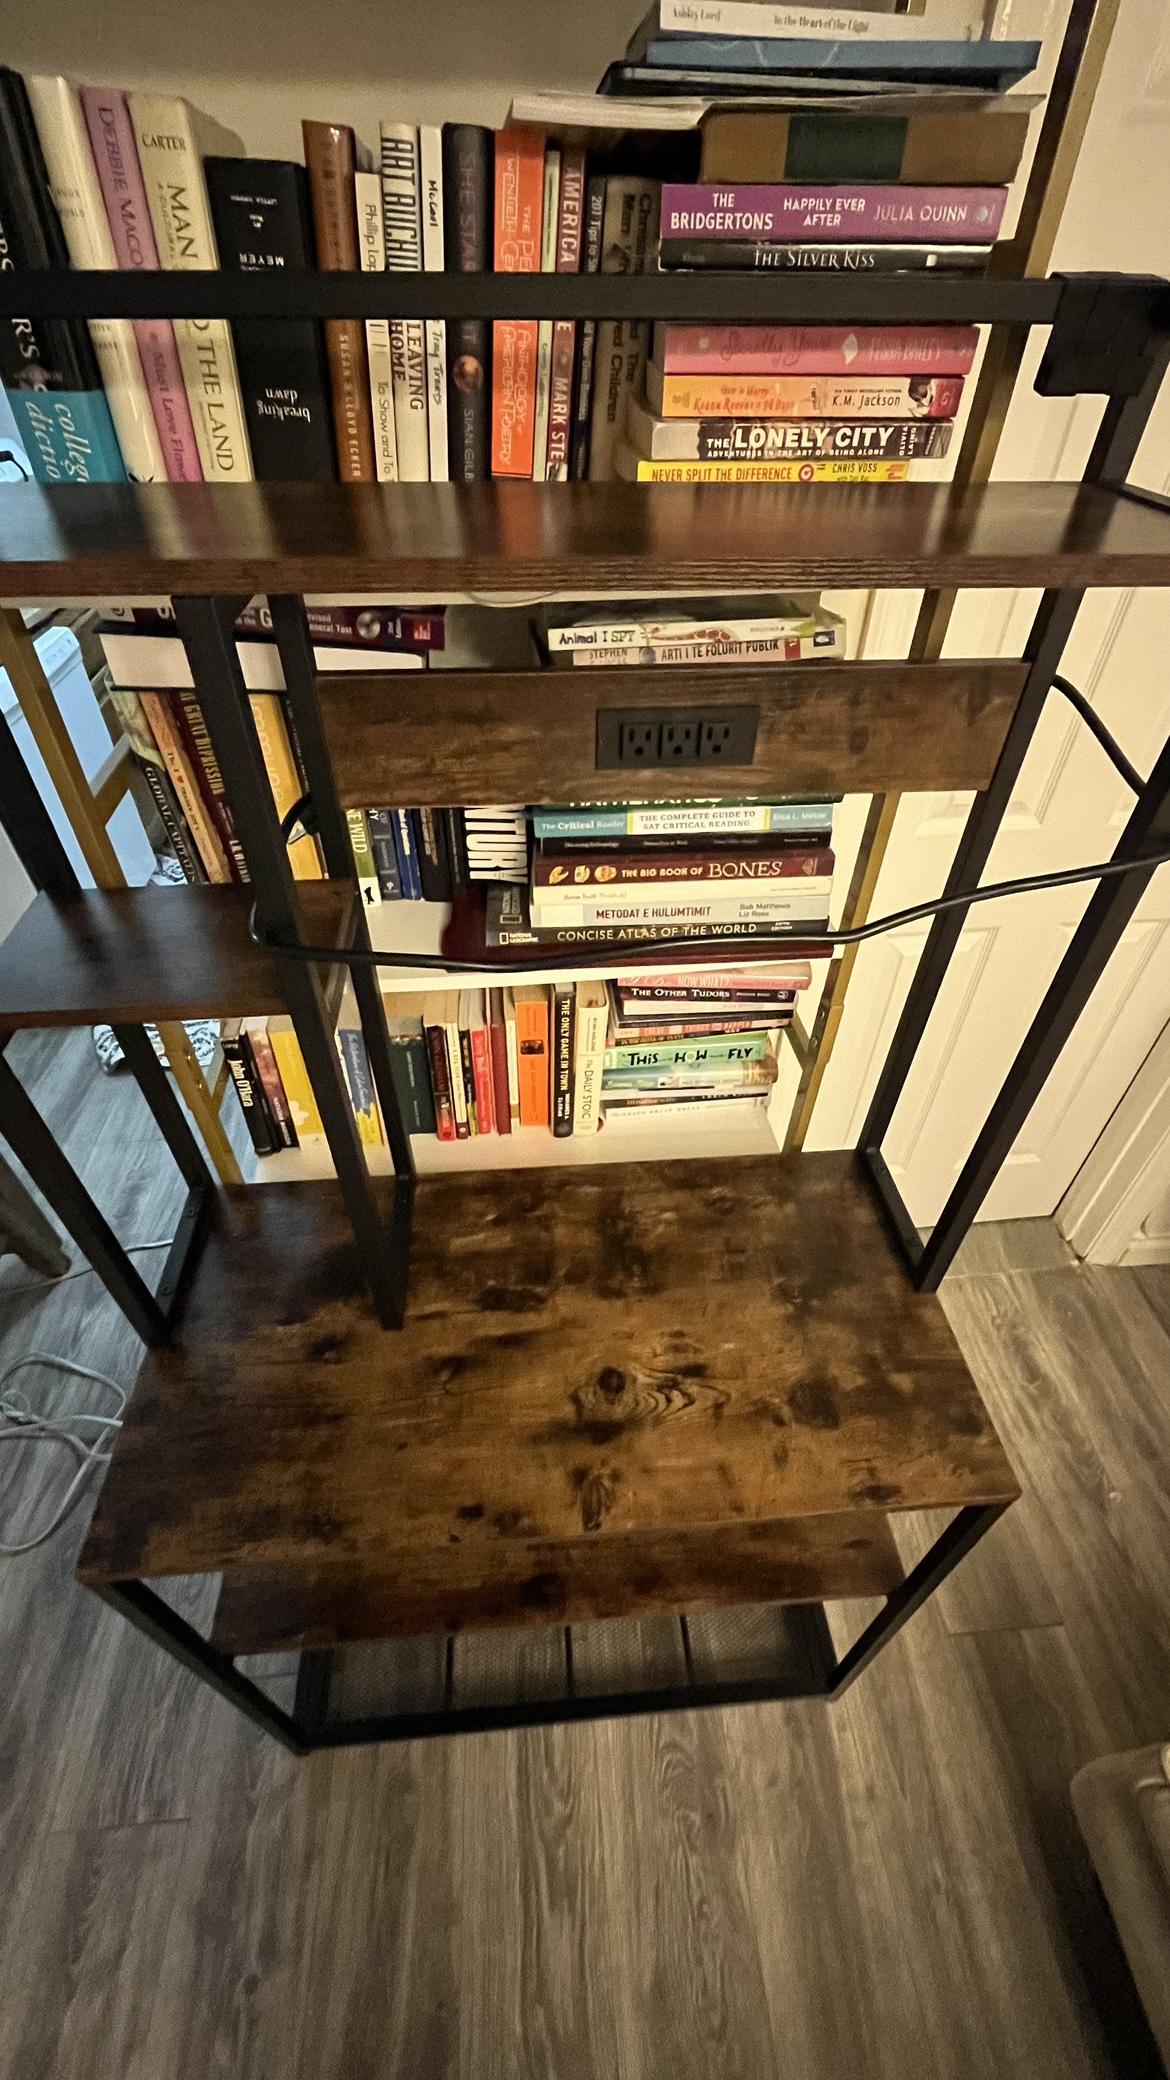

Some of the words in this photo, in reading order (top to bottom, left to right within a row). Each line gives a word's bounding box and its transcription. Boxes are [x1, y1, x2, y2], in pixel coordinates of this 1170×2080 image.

[99, 107, 128, 191] DEBBIE
[142, 134, 186, 150] CARTER
[381, 137, 415, 186] ART
[591, 196, 602, 217] 201
[712, 193, 735, 208] THE
[783, 198, 834, 212] HAPPILY
[835, 198, 866, 212] EVER
[167, 184, 198, 259] MAN
[522, 205, 531, 233] THE
[560, 167, 581, 262] AMERICA
[671, 212, 773, 230] BRIDGERTONS
[803, 213, 841, 227] AFTER
[873, 204, 914, 222] JULIA
[919, 205, 968, 222] QUINN
[364, 203, 378, 246] Phillip
[587, 219, 601, 244] Tips
[239, 253, 284, 267] MEYER
[754, 248, 781, 268] THE
[340, 335, 351, 376] SUSAN
[389, 319, 406, 382] HOME
[197, 339, 222, 395] THE
[406, 322, 424, 410] LEAVING
[515, 329, 531, 424] ANTHOLOGY
[265, 388, 298, 404] dawn
[377, 381, 388, 394] To
[606, 354, 623, 422] Children
[552, 377, 568, 425] MARK
[832, 394, 855, 407] K.M.
[858, 394, 900, 409] Jackson
[163, 398, 177, 435] Love
[257, 401, 311, 423] breaking
[345, 396, 357, 434] LLOYD
[379, 397, 390, 432] Show
[207, 402, 235, 471] LAND
[464, 409, 475, 443] SIAN
[500, 402, 516, 465] POETRY
[381, 437, 393, 458] and
[707, 438, 730, 449] THE
[735, 427, 830, 449] LONELY
[836, 427, 894, 447] CITY
[899, 425, 908, 456] OLIVIA
[908, 427, 917, 455] LAING
[351, 440, 361, 477] ECKER
[707, 450, 762, 458] ADVENTURES
[652, 468, 685, 482] NEVER
[686, 468, 713, 481] SPLIT
[715, 467, 733, 481] THE
[735, 467, 792, 481] DIFFERENCE
[833, 463, 855, 473] CHRIS
[858, 463, 877, 472] VOSS
[336, 625, 352, 635] Test
[559, 631, 597, 646] Animal
[602, 632, 607, 642] I
[611, 630, 635, 642] SPY
[661, 648, 682, 661] ARTI
[705, 643, 742, 657] FOLURIT
[745, 640, 780, 653] PUBLIK
[195, 737, 225, 795] DEPRESSION
[146, 767, 171, 819] GLOBAL
[557, 819, 594, 831] Critical
[640, 814, 658, 822] THE
[660, 812, 710, 822] COMPLETE
[712, 811, 741, 820] GUIDE
[743, 810, 756, 819] TO
[643, 822, 660, 830] SAT
[662, 821, 706, 830] CRITICAL
[708, 819, 750, 829] READING
[773, 812, 790, 821] Erica
[350, 823, 367, 853] WILD
[621, 868, 637, 878] THE
[640, 868, 657, 877] BIG
[660, 867, 687, 877] BOOK
[689, 866, 703, 876] OF
[707, 862, 783, 879] BONES
[596, 908, 641, 920] METODAT
[643, 908, 649, 918] E
[652, 906, 712, 918] HULUMTIMIT
[755, 902, 791, 910] Matthews
[557, 930, 614, 942] CONCISE
[617, 927, 656, 939] ATLAS
[661, 927, 679, 938] OF
[682, 926, 707, 937] THE
[711, 923, 757, 936] WORLD
[677, 976, 699, 986] NOW
[700, 976, 730, 987] WHAT?
[631, 988, 651, 997] THE
[654, 988, 687, 997] OTHER
[691, 989, 730, 998] TUDORS
[561, 1000, 570, 1015] THE
[561, 1017, 570, 1036] ONLY
[561, 1036, 570, 1059] GAME
[674, 1050, 708, 1064] HOW
[727, 1048, 753, 1060] FLY
[560, 1059, 569, 1069] IN
[227, 1059, 245, 1079] John
[236, 1080, 254, 1108] O'Hara
[560, 1070, 569, 1091] TOWN
[583, 1070, 594, 1095] DAILY
[581, 1095, 592, 1119] STOIC
